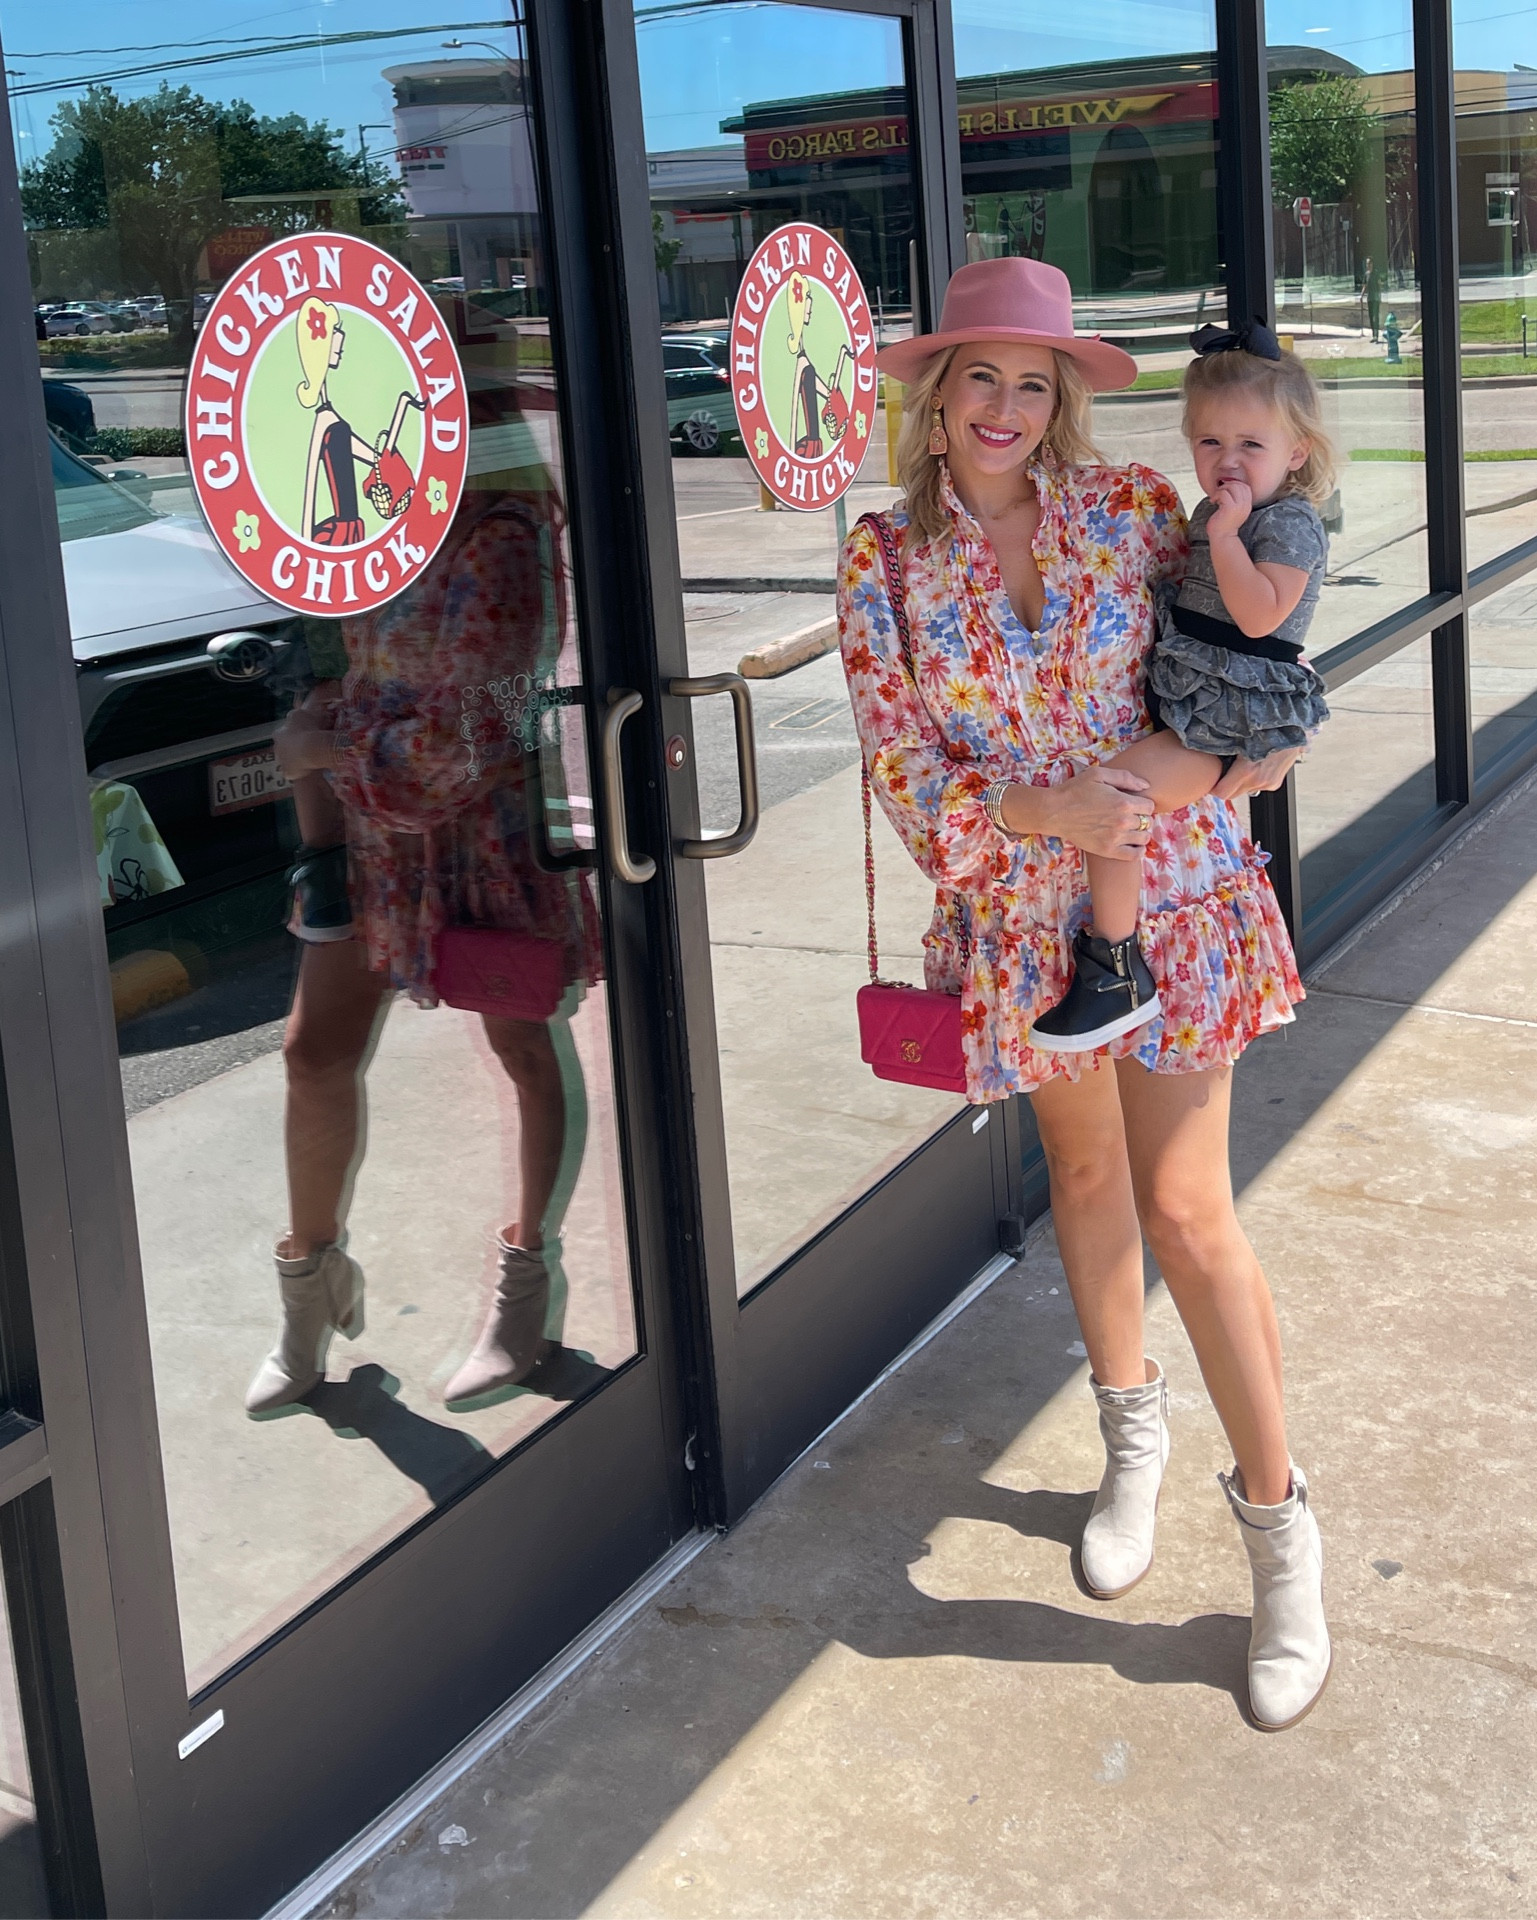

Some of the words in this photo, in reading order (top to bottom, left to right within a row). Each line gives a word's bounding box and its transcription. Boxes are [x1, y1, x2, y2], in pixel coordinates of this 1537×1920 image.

[195, 246, 344, 490] CHICKEN
[366, 263, 461, 452] SALAD
[735, 233, 812, 412] CHICKEN
[823, 246, 873, 393] SALAD
[774, 443, 855, 502] CHICK
[272, 522, 426, 604] CHICK
